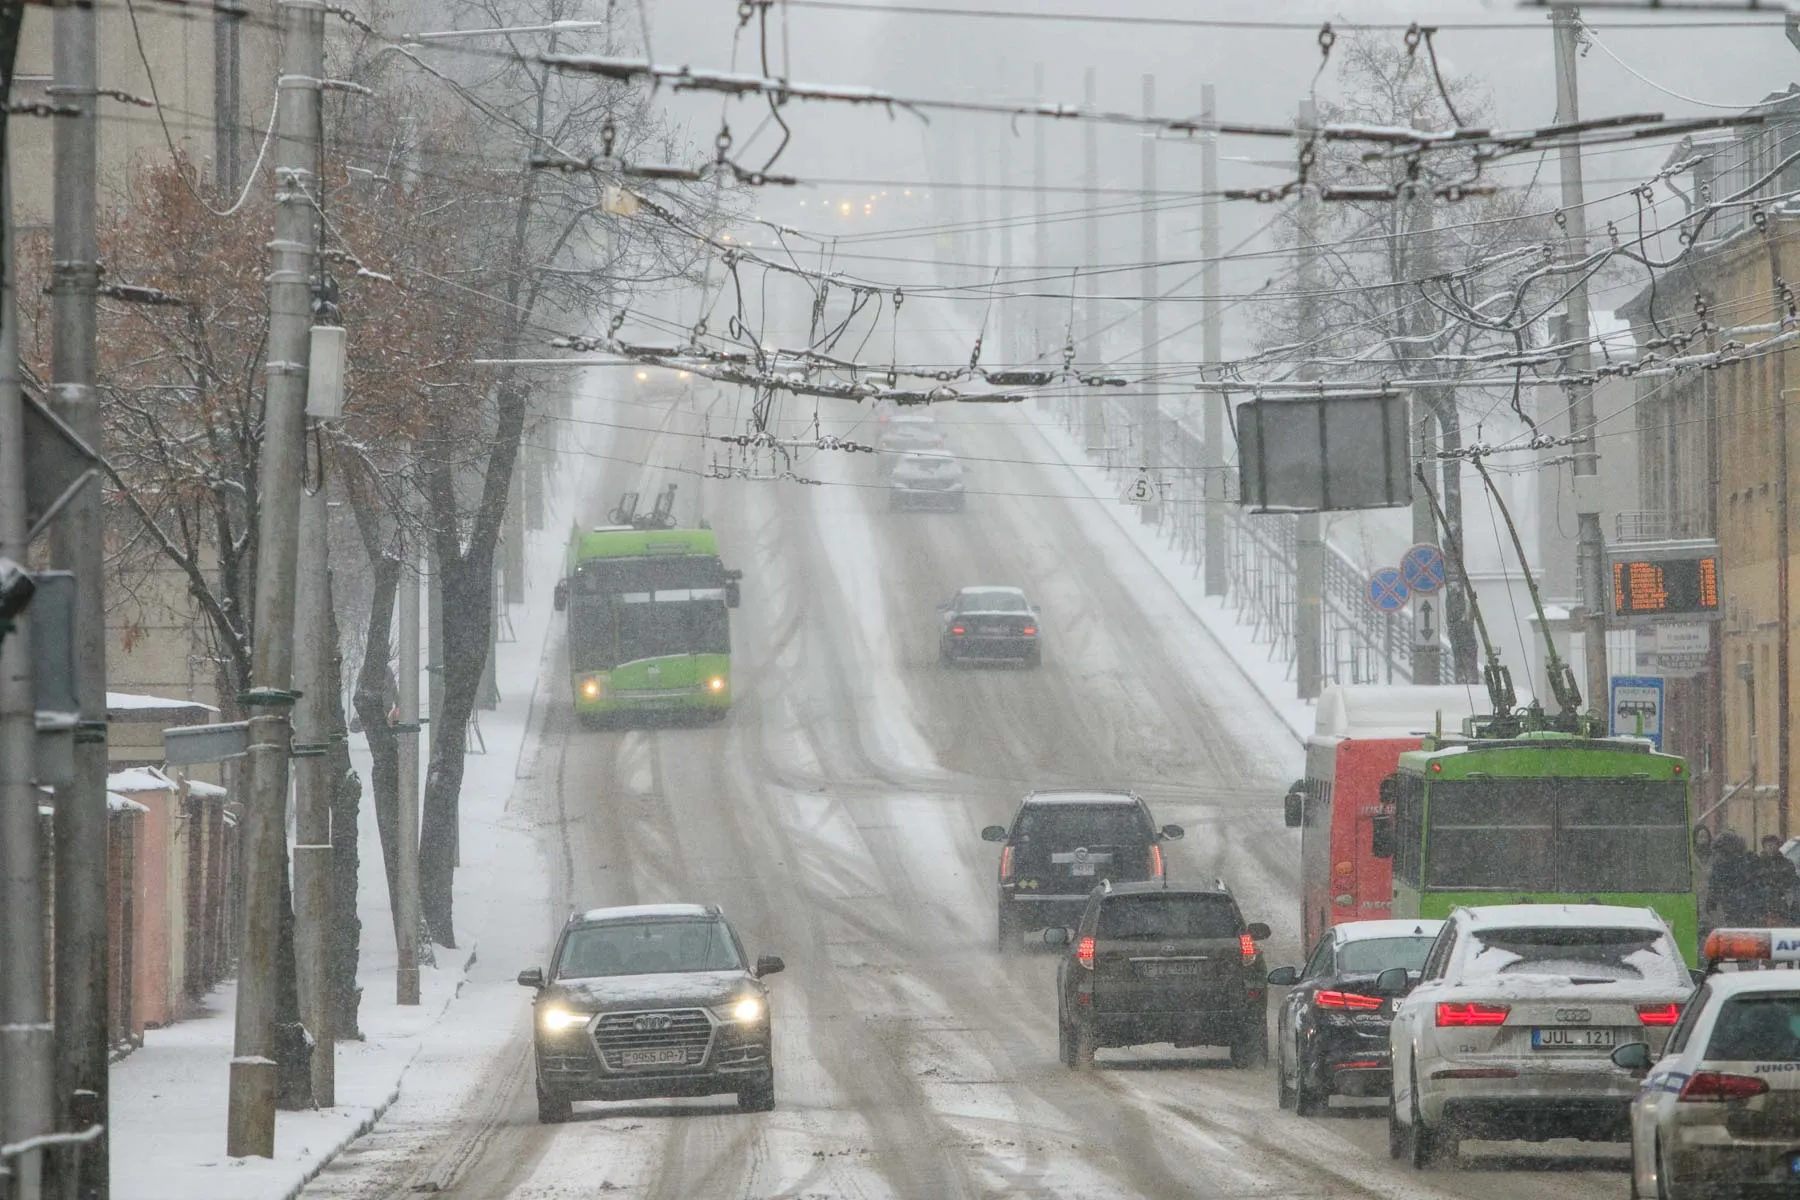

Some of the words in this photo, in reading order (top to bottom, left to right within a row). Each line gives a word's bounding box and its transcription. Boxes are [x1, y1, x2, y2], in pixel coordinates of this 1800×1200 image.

[1136, 481, 1146, 497] 5
[1542, 1031, 1573, 1044] JUL
[1586, 1031, 1609, 1044] 121
